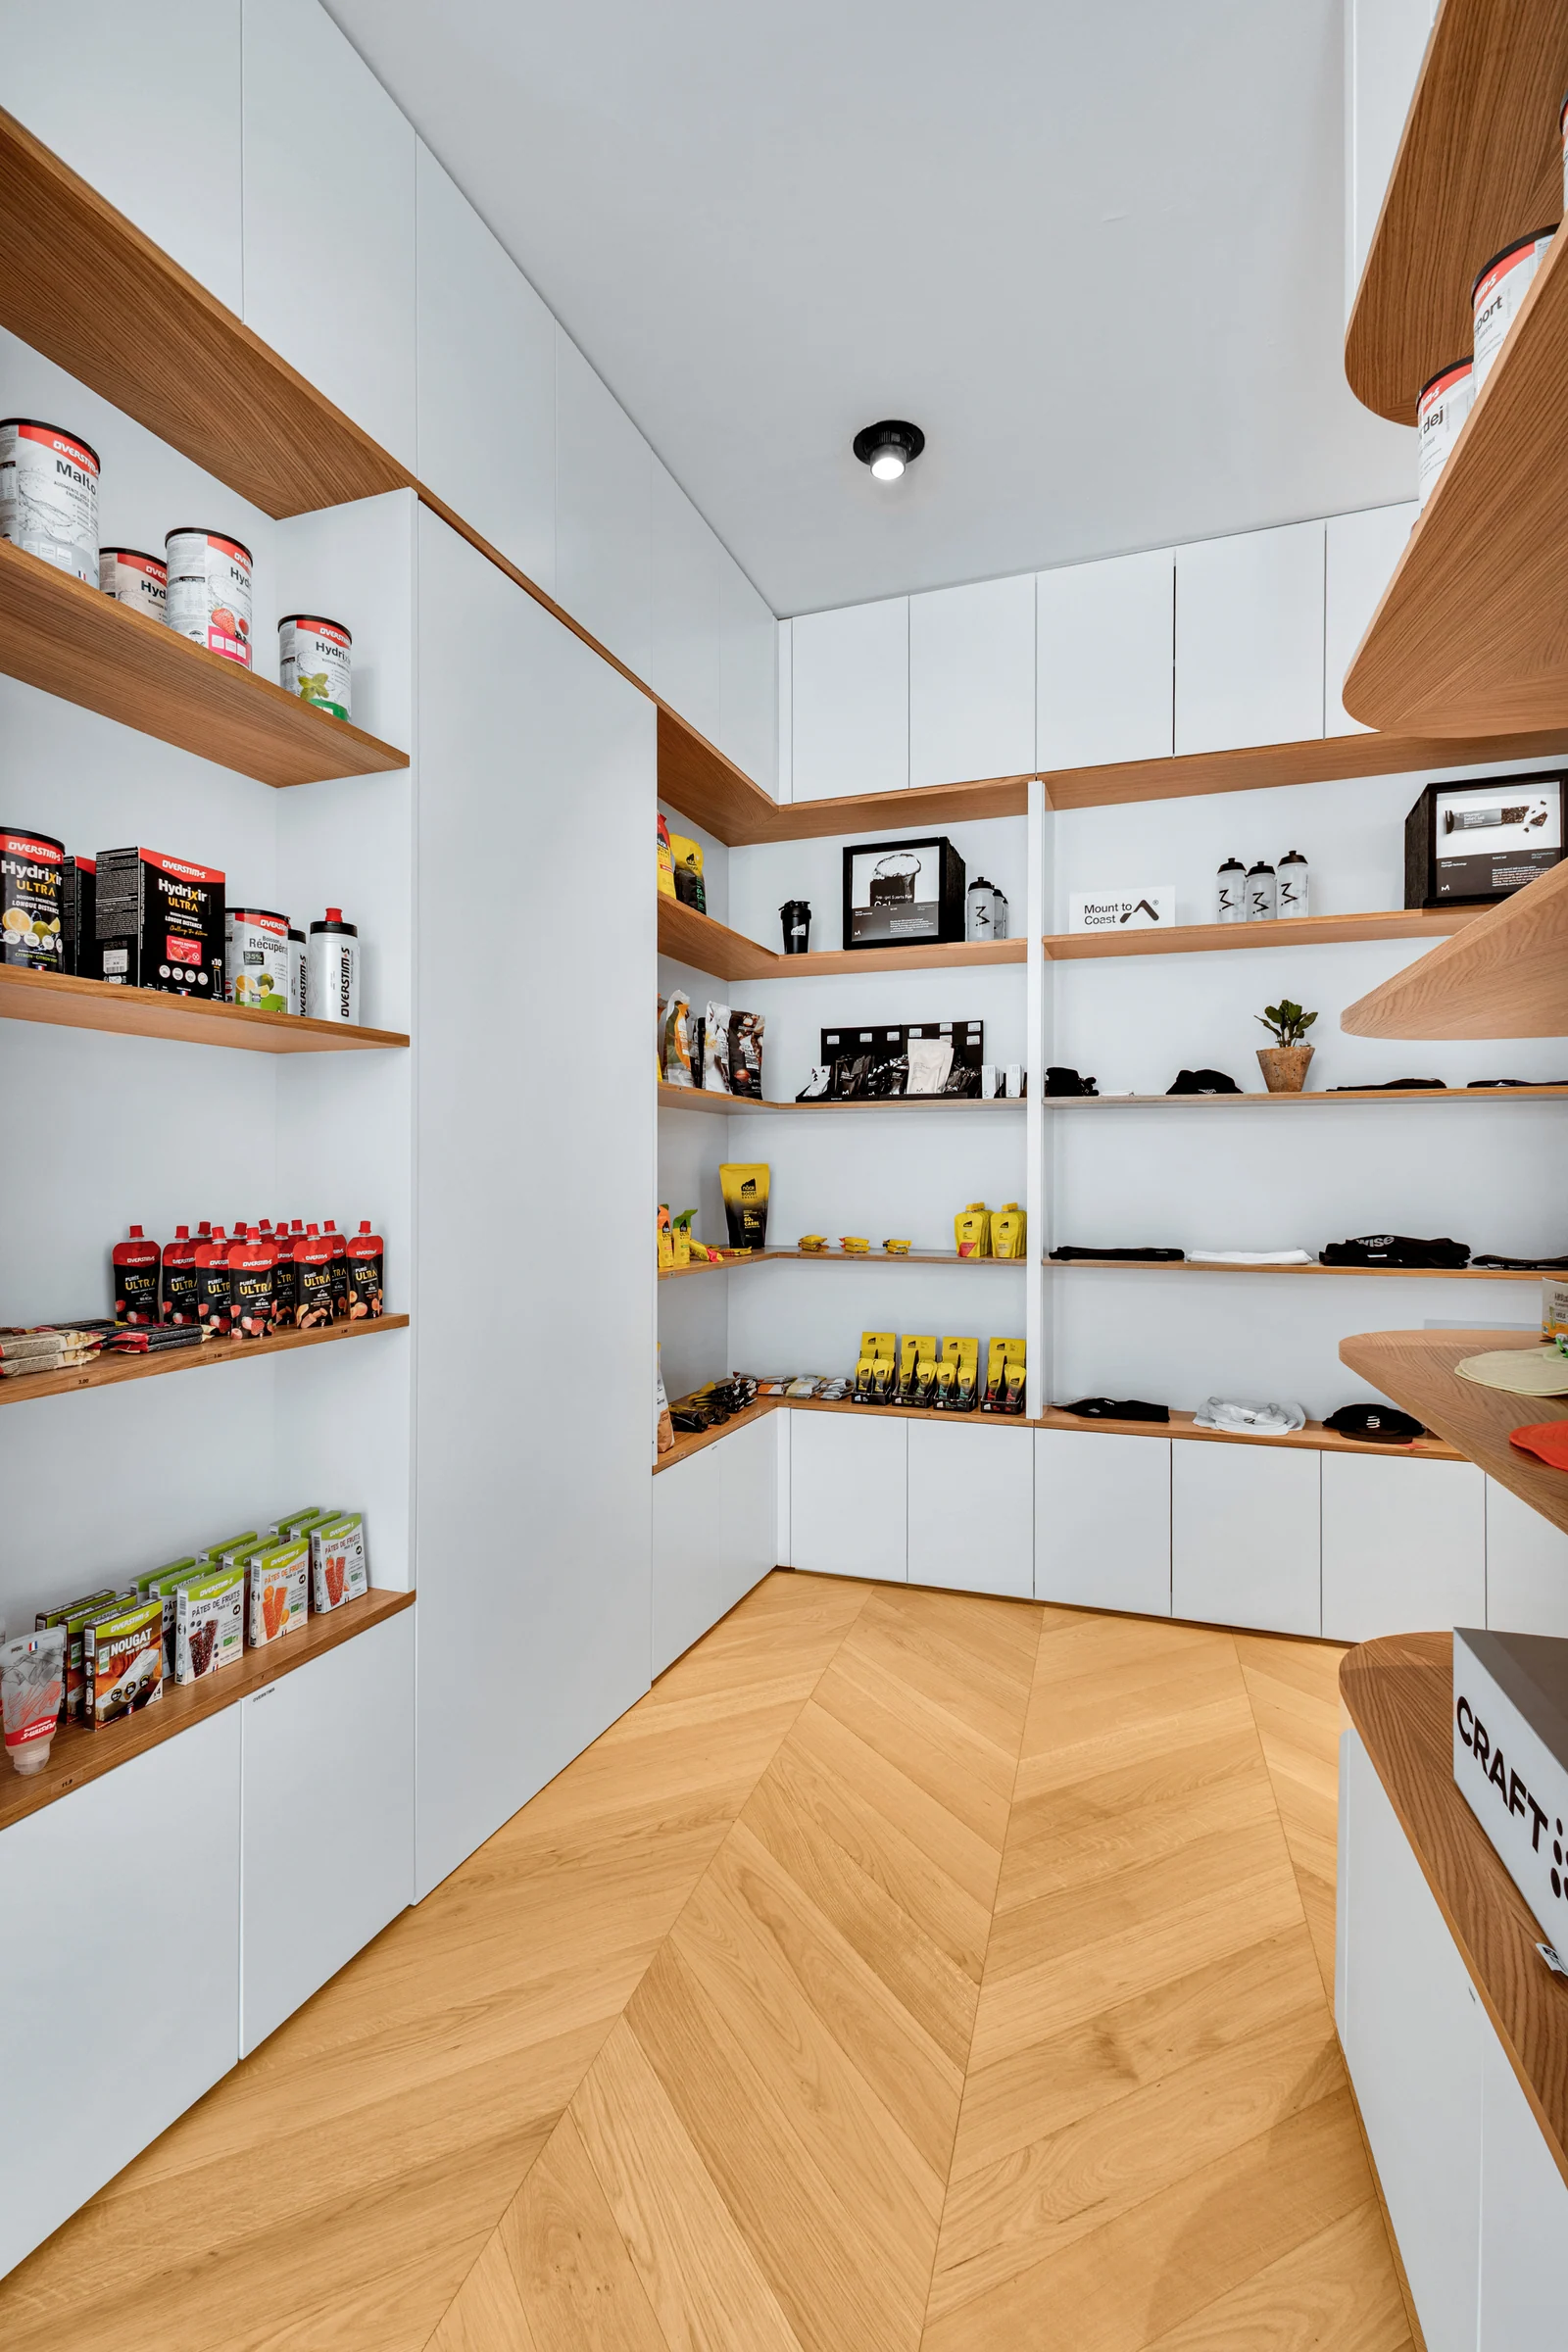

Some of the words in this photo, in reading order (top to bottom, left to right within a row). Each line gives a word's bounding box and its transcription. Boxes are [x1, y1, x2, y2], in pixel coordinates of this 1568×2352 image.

[56, 460, 96, 496] Malto
[1, 860, 62, 886] Hydrixir
[17, 879, 55, 897] ULTRA
[158, 878, 208, 903] Hydrixir
[12, 900, 37, 909] LONGUE
[168, 897, 199, 912] ULTRA
[1084, 904, 1119, 914] Mount
[1122, 903, 1133, 911] to
[1084, 914, 1116, 925] Coast
[212, 957, 222, 967] x10
[304, 1273, 331, 1287] ULTRA
[355, 1269, 378, 1281] ULTRA
[347, 1533, 361, 1544] FRUITS
[265, 1572, 280, 1585] PÂTES
[289, 1561, 306, 1573] FRUITS
[191, 1603, 211, 1618] PÂTES
[213, 1598, 220, 1608] DE
[221, 1590, 240, 1604] FRUITS
[111, 1628, 153, 1656] NOUGAT
[1456, 1695, 1548, 1854] CRAFT
